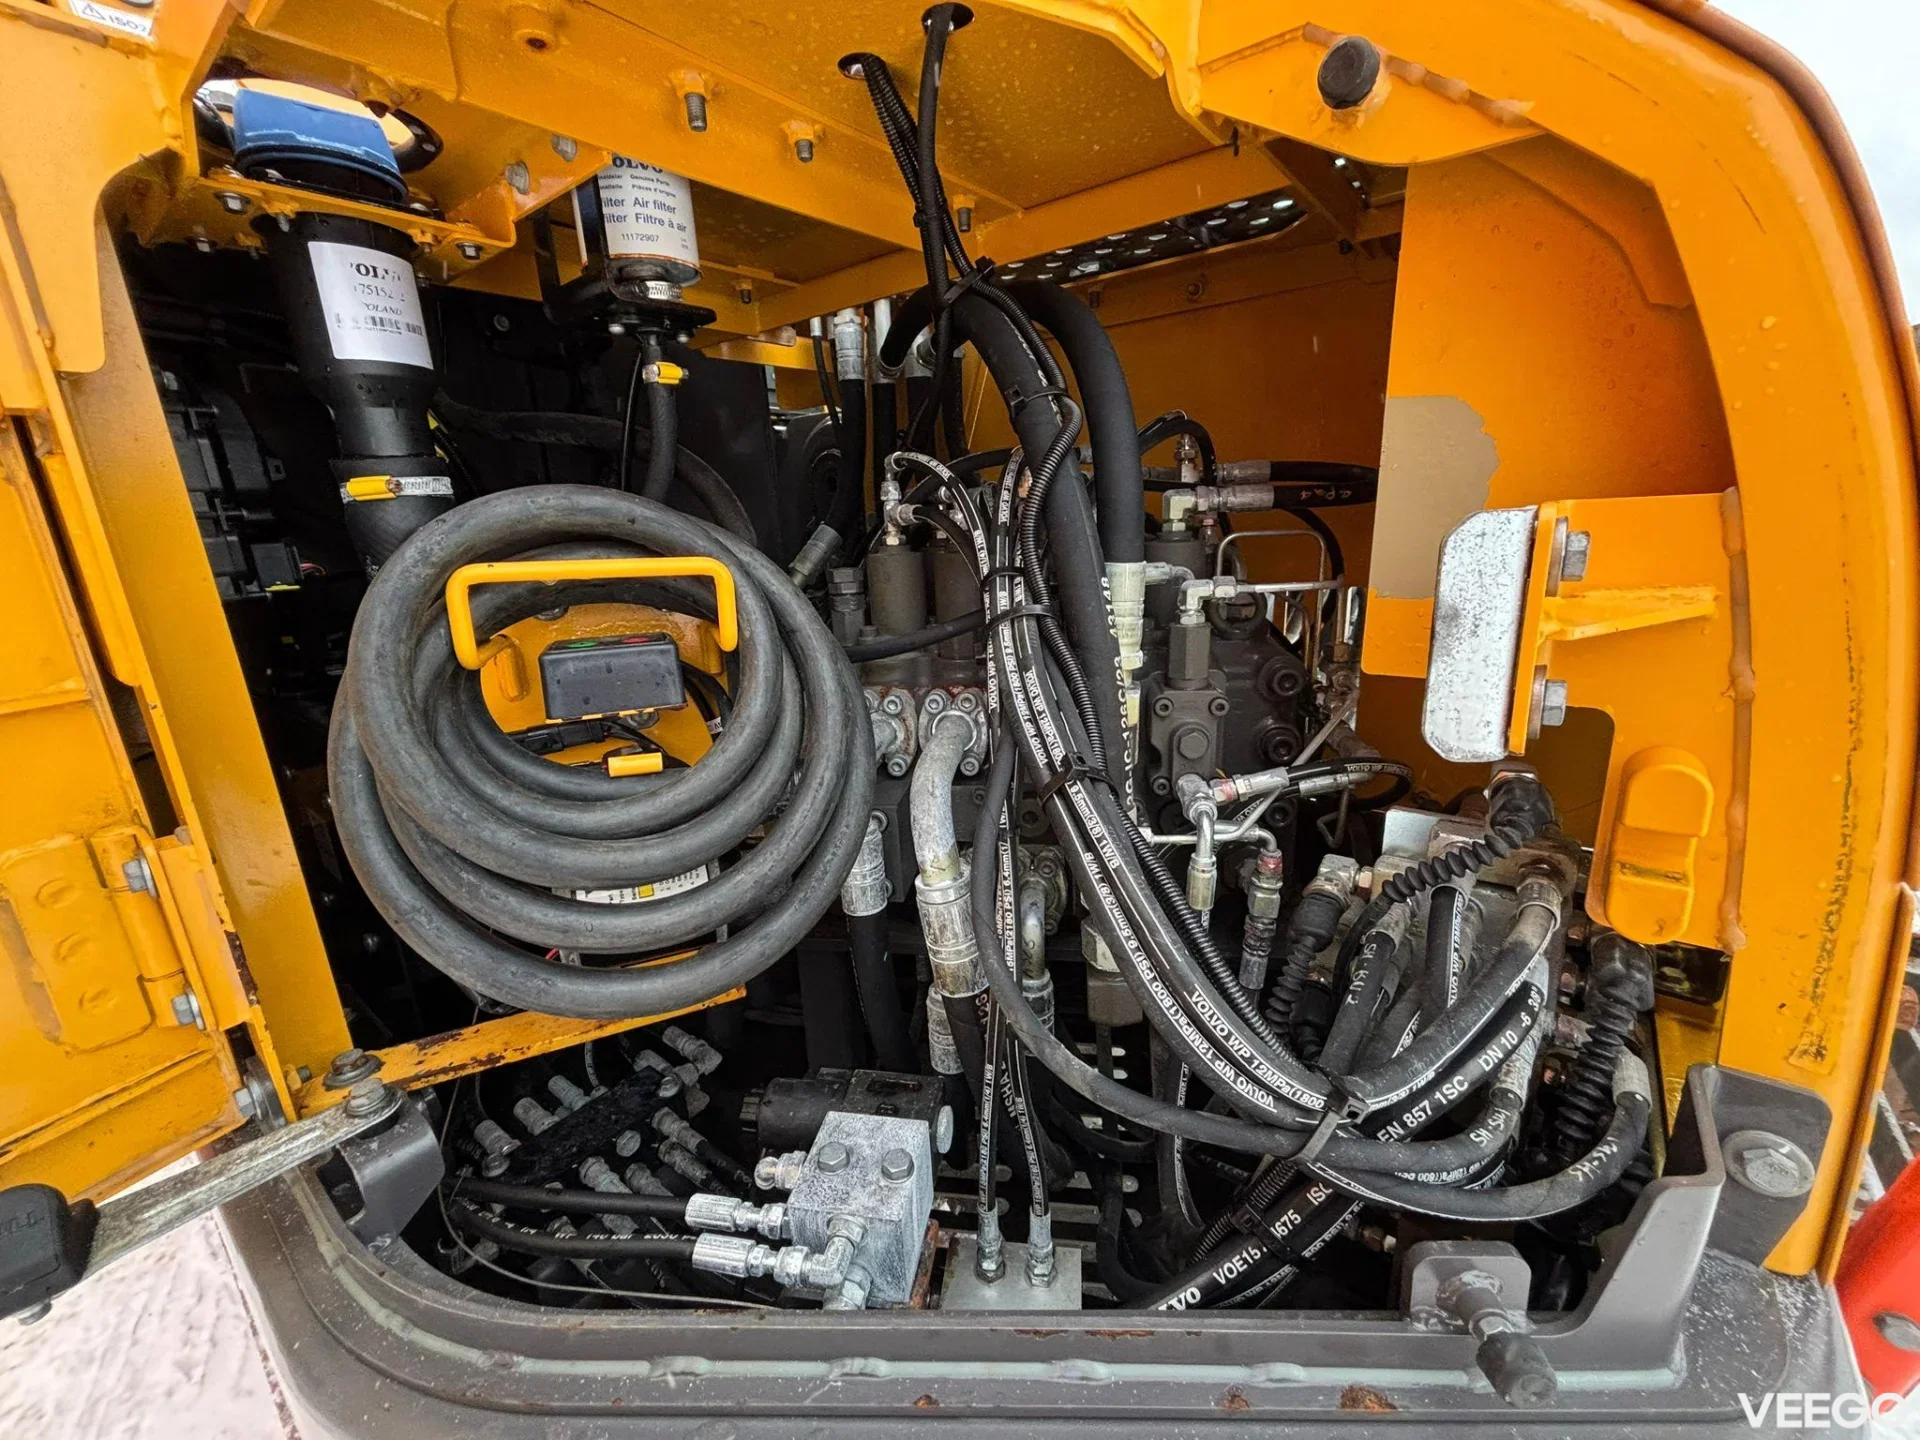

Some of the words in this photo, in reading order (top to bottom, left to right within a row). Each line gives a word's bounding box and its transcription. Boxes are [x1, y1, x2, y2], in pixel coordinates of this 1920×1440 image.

[633, 197, 650, 209] Air
[652, 199, 677, 215] filter
[635, 212, 665, 227] Filtre
[668, 218, 675, 228] à
[676, 222, 687, 233] air
[621, 233, 660, 243] 11172907
[988, 678, 998, 710] VOLVO
[1025, 669, 1039, 697] VOLVO
[1033, 696, 1045, 712] WP
[1025, 721, 1037, 737] WP
[1031, 737, 1049, 765] VOLVO
[1083, 852, 1102, 880] 1W/B
[1099, 839, 1120, 870] 1W/B
[1099, 882, 1139, 950] 9.5mm(3/8)
[1133, 951, 1155, 981] PSI)
[1152, 981, 1213, 1060] 12MPa(1800
[1190, 991, 1229, 1037] VOLVO
[1228, 1036, 1251, 1060] WP
[1250, 1058, 1325, 1110] 12MPa(1800
[1214, 1058, 1236, 1082] WP
[1402, 1099, 1434, 1129] 857
[1433, 1074, 1469, 1106] 1SC
[1477, 1048, 1505, 1073] DN
[1500, 1029, 1519, 1050] 10
[1237, 1077, 1275, 1109] VOLVO
